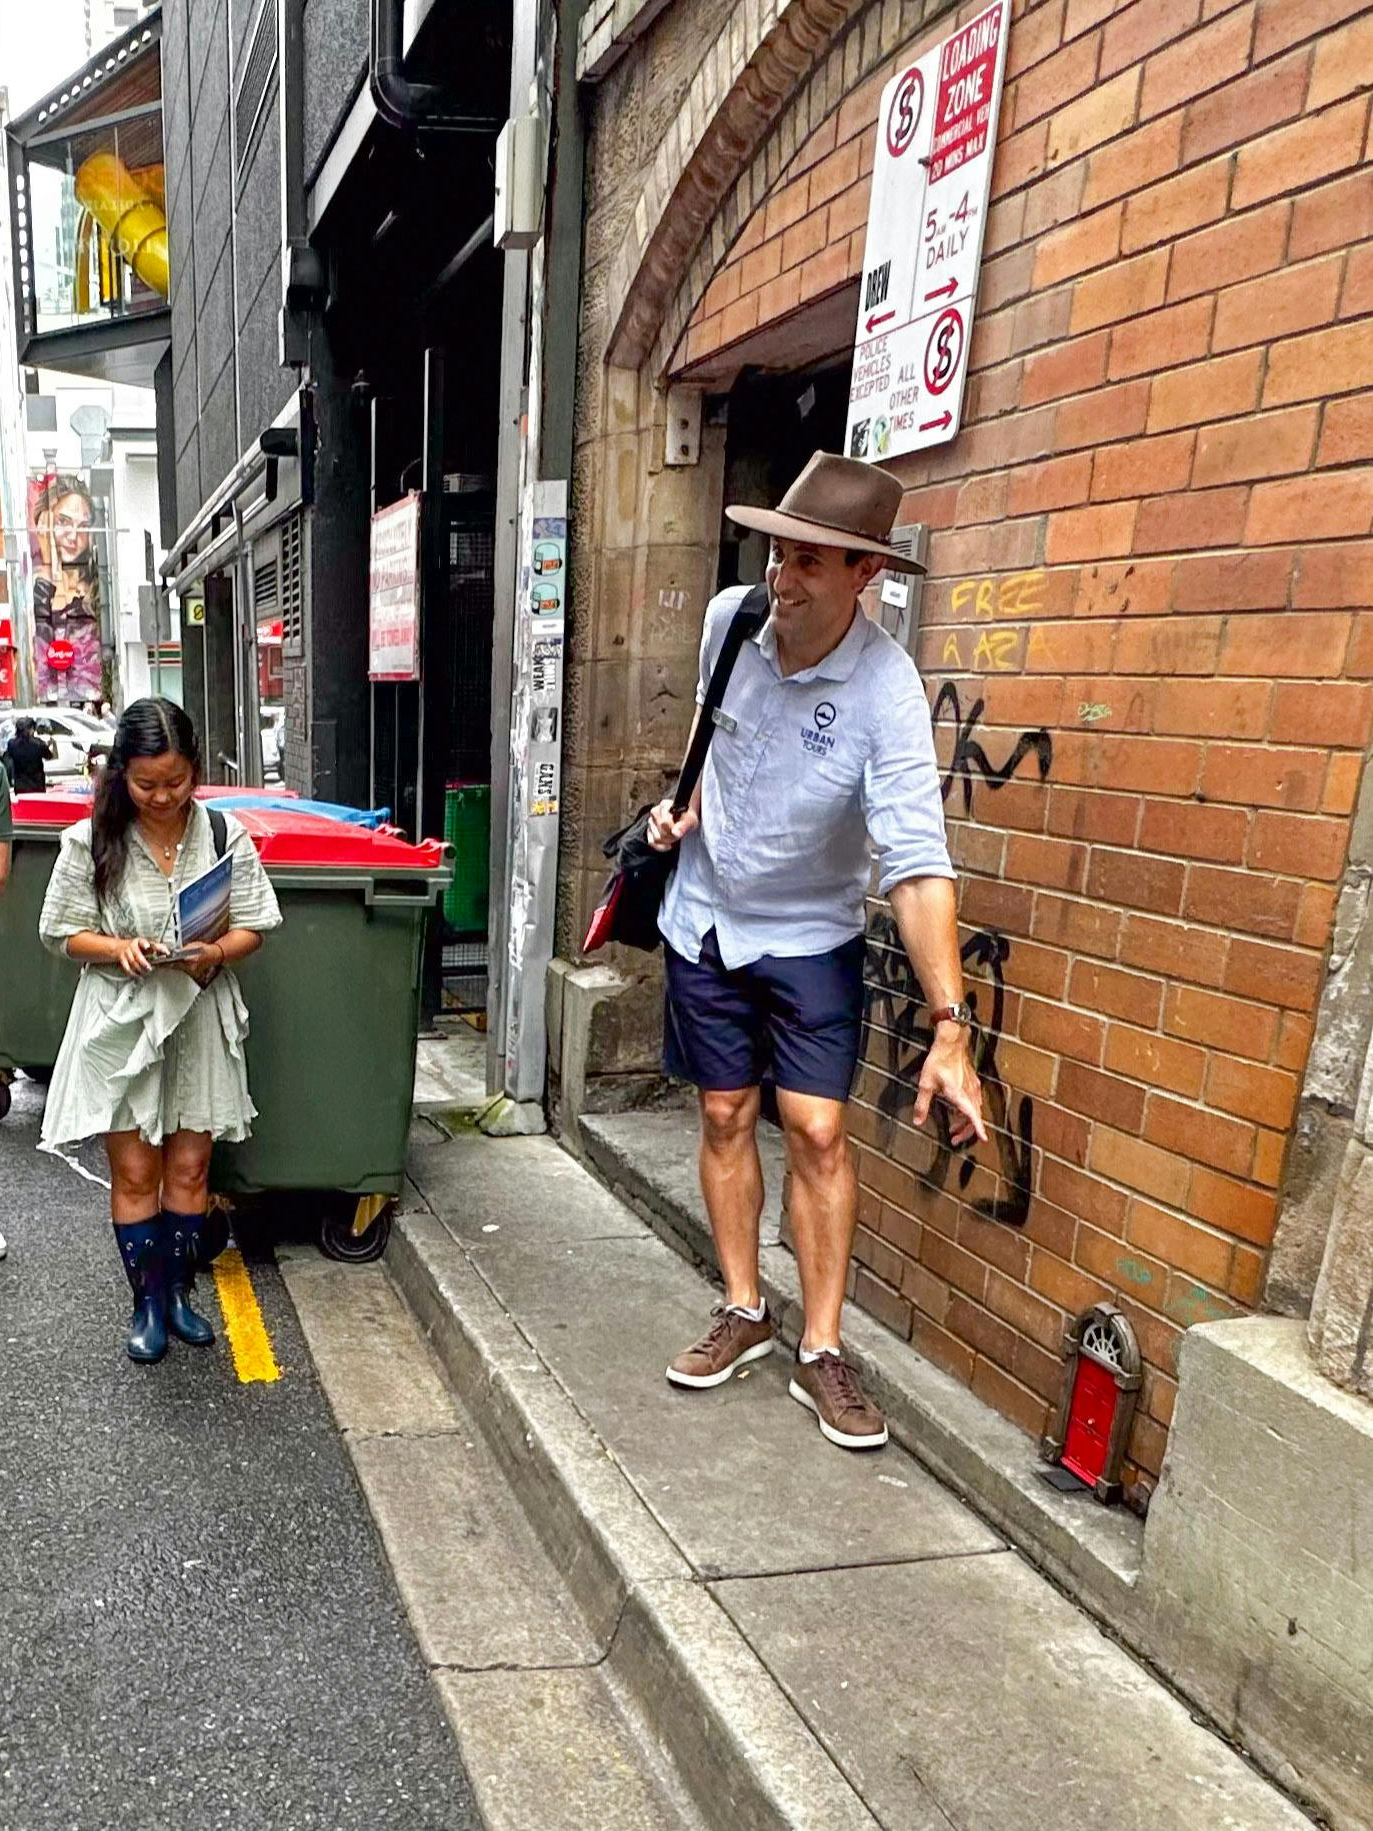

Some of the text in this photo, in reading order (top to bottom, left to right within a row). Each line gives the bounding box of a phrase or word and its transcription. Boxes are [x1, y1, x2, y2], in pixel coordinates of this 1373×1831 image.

[942, 9, 1000, 82] LOADING
[944, 63, 987, 123] ZONE
[931, 131, 985, 181] 20 MINS MAX
[926, 225, 969, 270] DAILY
[858, 336, 889, 362] POLICE
[852, 354, 891, 383] VEHICLES
[897, 362, 916, 385] ALL
[849, 374, 890, 404] EXCEPTED
[889, 386, 920, 411] OTHER
[889, 411, 915, 434] TIMES
[951, 568, 1045, 617] FREE
[800, 727, 836, 749] URBAN
[803, 739, 828, 756] TOURS
